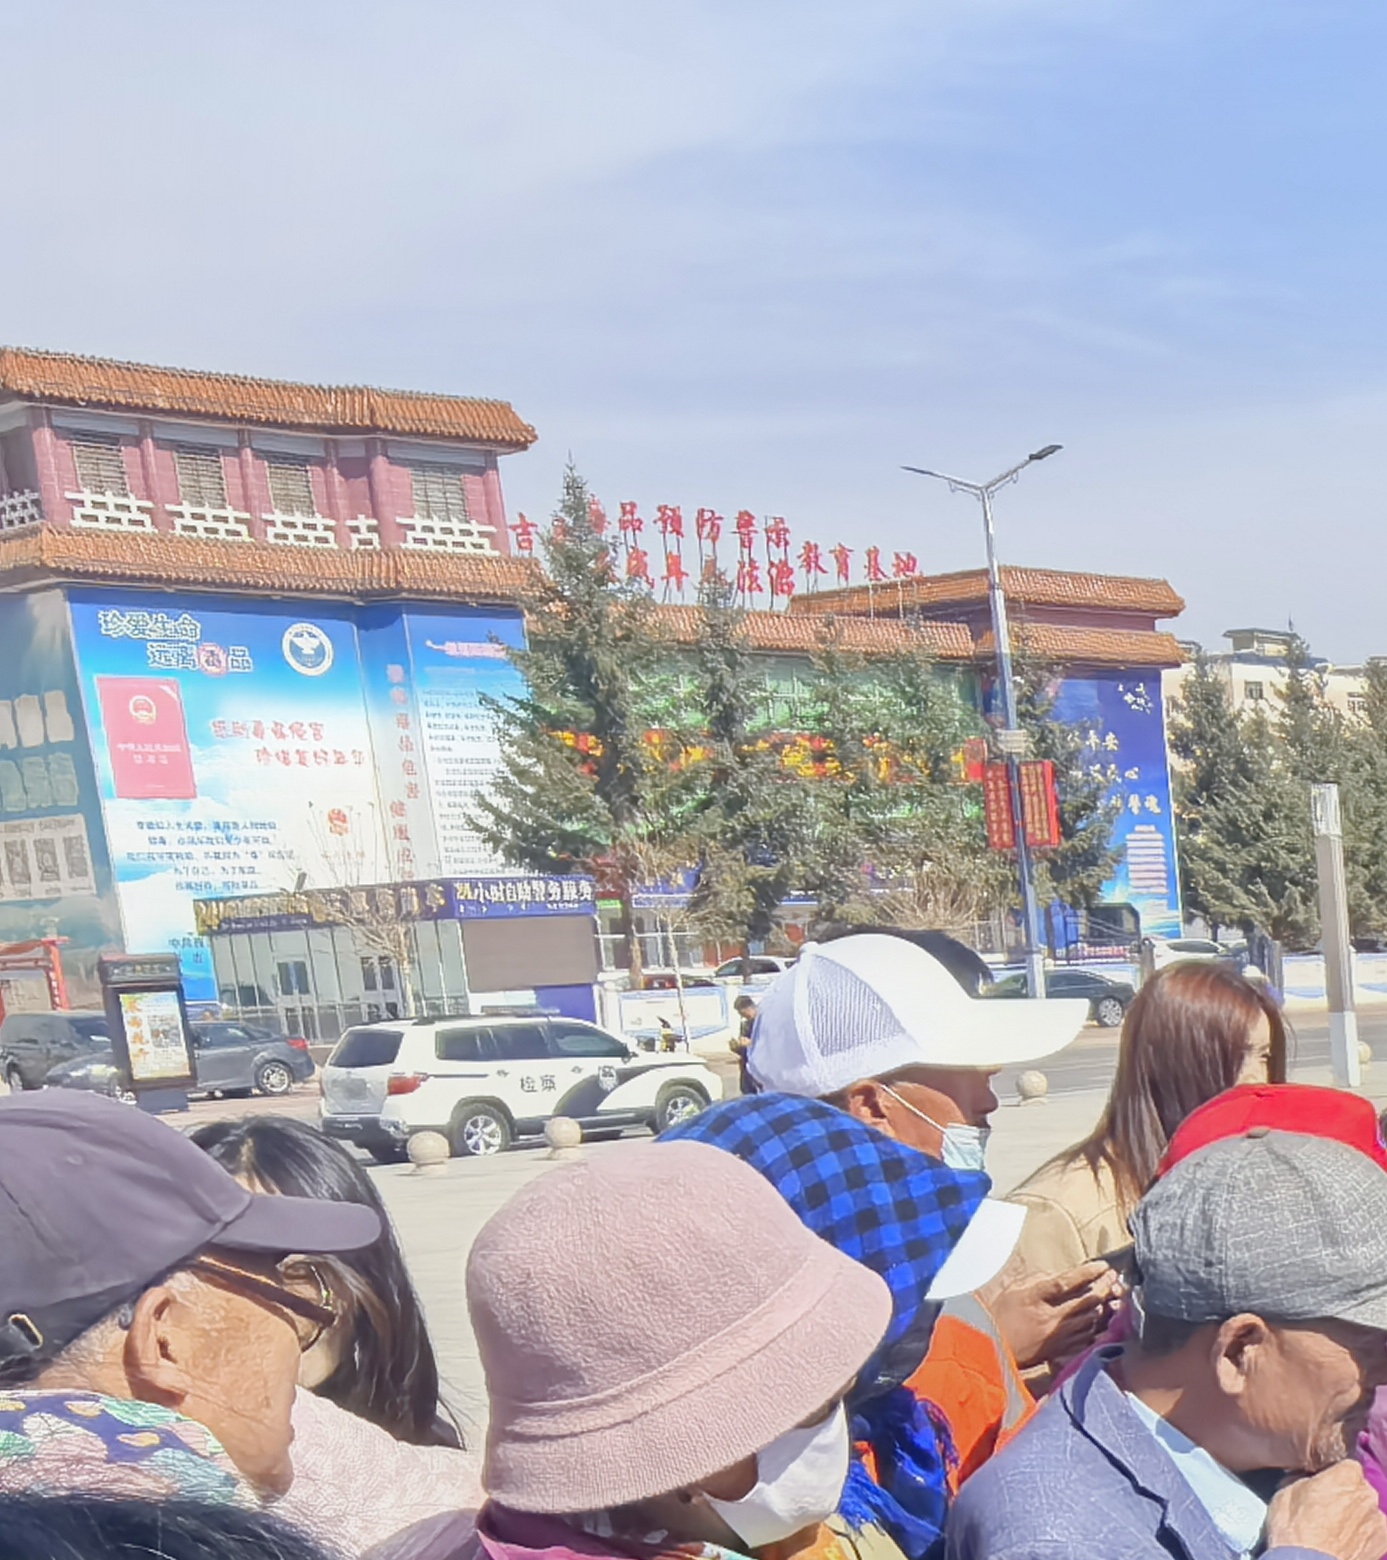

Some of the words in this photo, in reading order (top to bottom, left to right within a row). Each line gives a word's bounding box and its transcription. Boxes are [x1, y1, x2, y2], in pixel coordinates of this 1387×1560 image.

[797, 540, 919, 582] 教育基地
[98, 610, 201, 641] 珍爱生命
